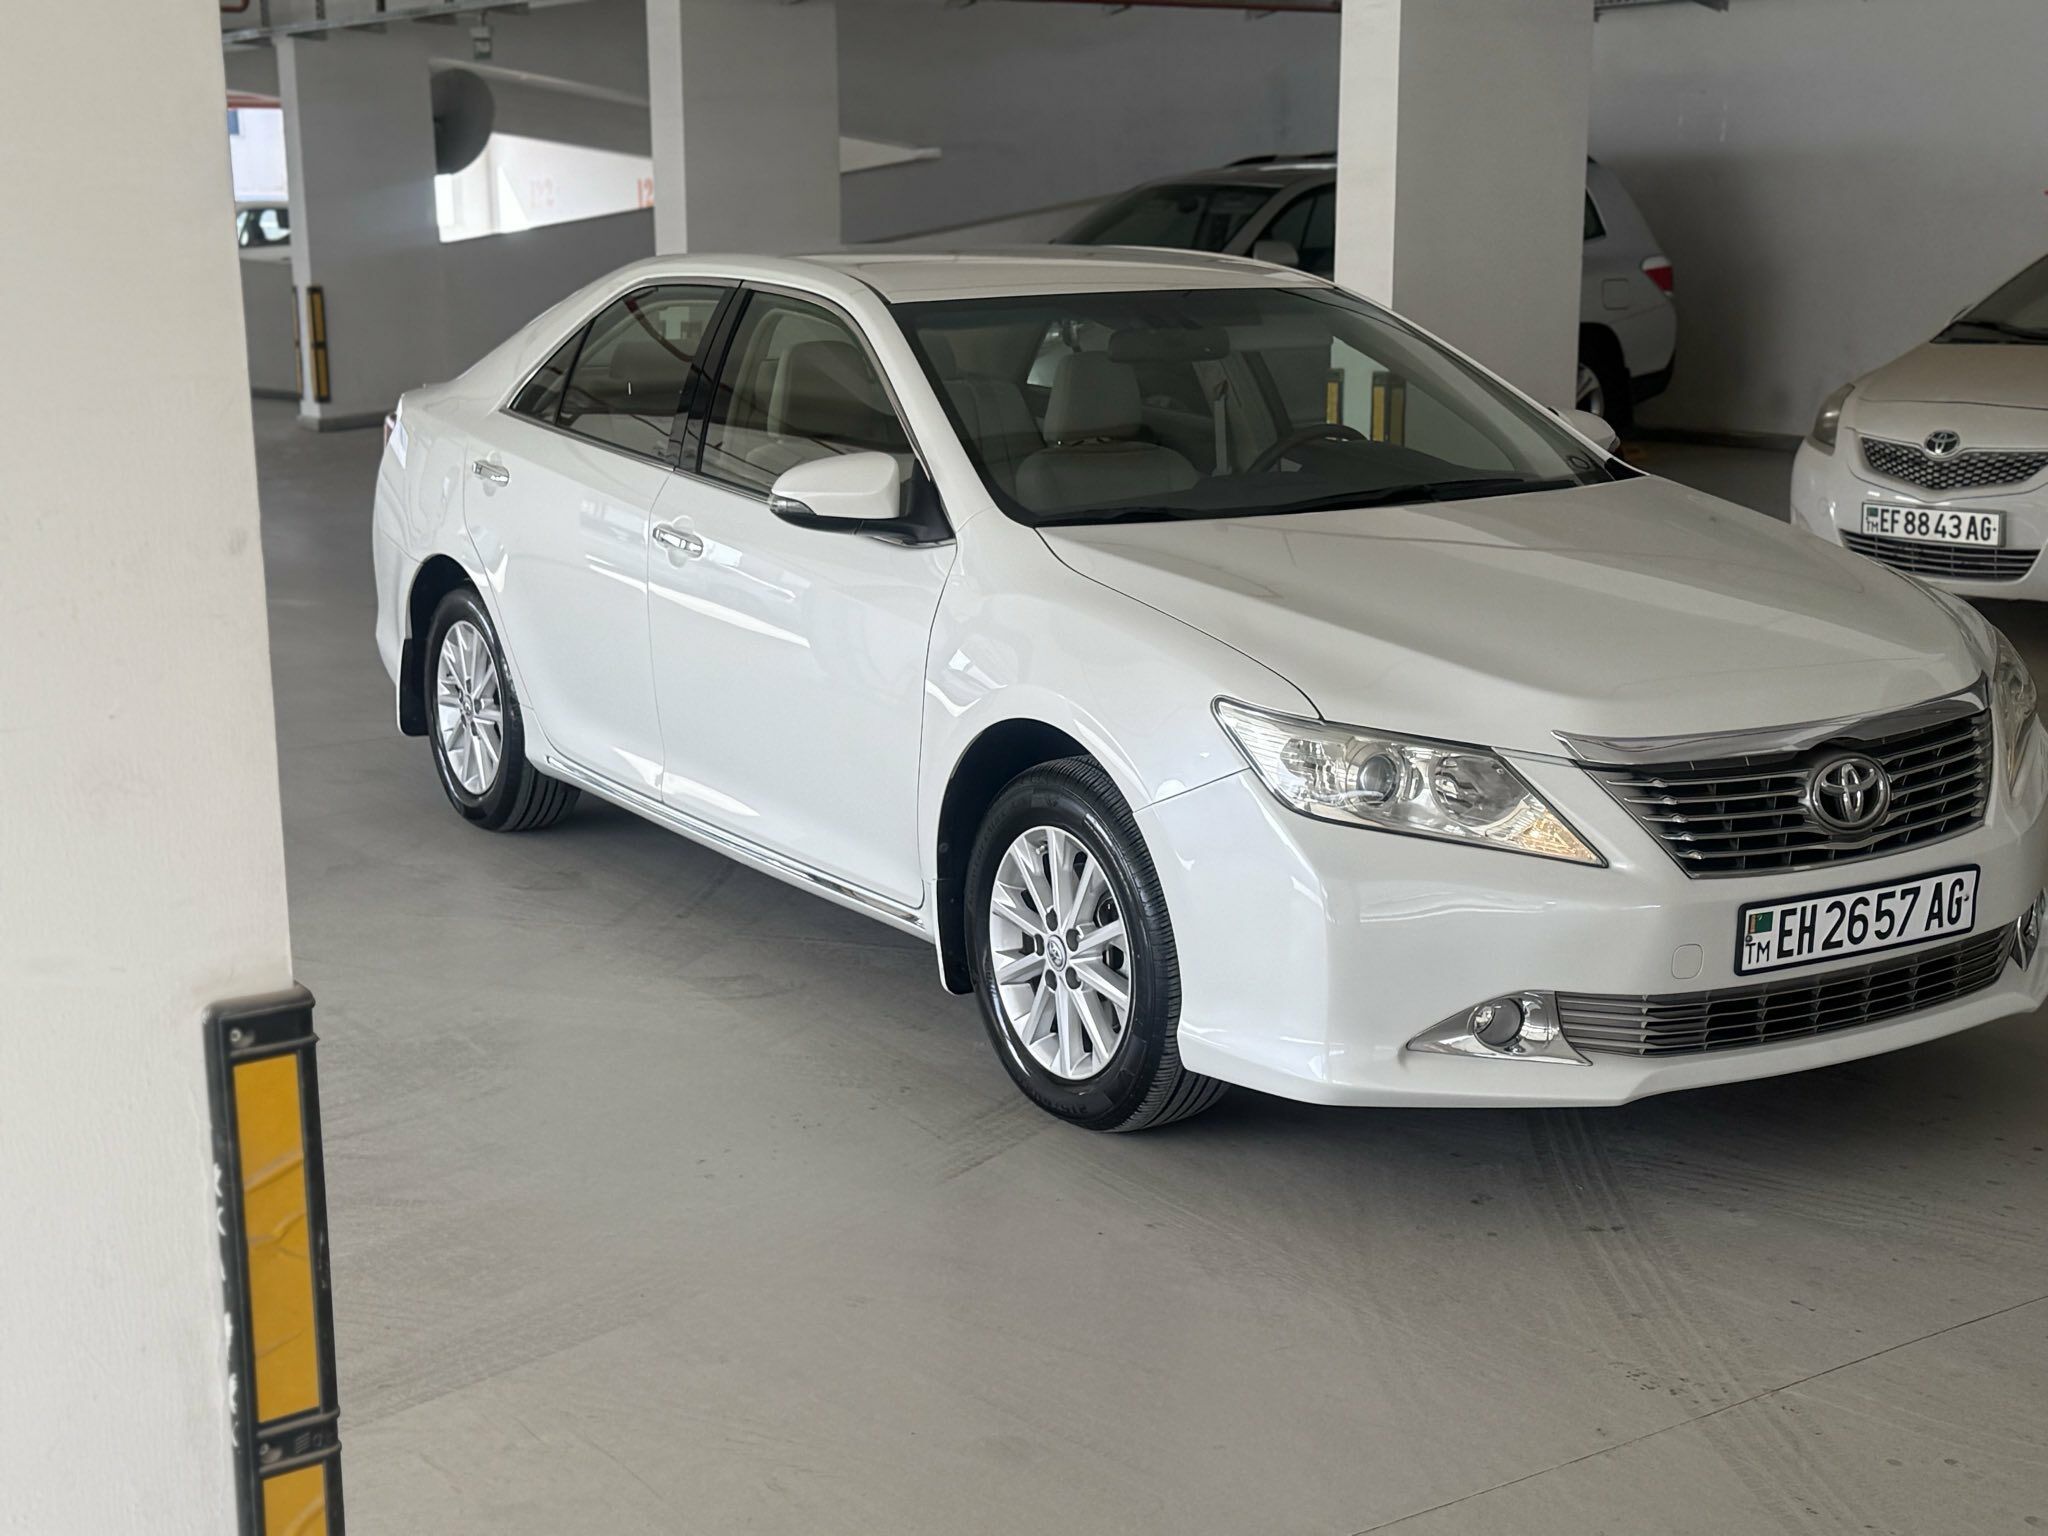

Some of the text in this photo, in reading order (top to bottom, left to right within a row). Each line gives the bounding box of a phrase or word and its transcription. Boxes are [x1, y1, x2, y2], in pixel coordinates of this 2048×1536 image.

[1966, 516, 1991, 541] AG
[1925, 878, 1964, 932] AG
[1745, 940, 1771, 964] TM
